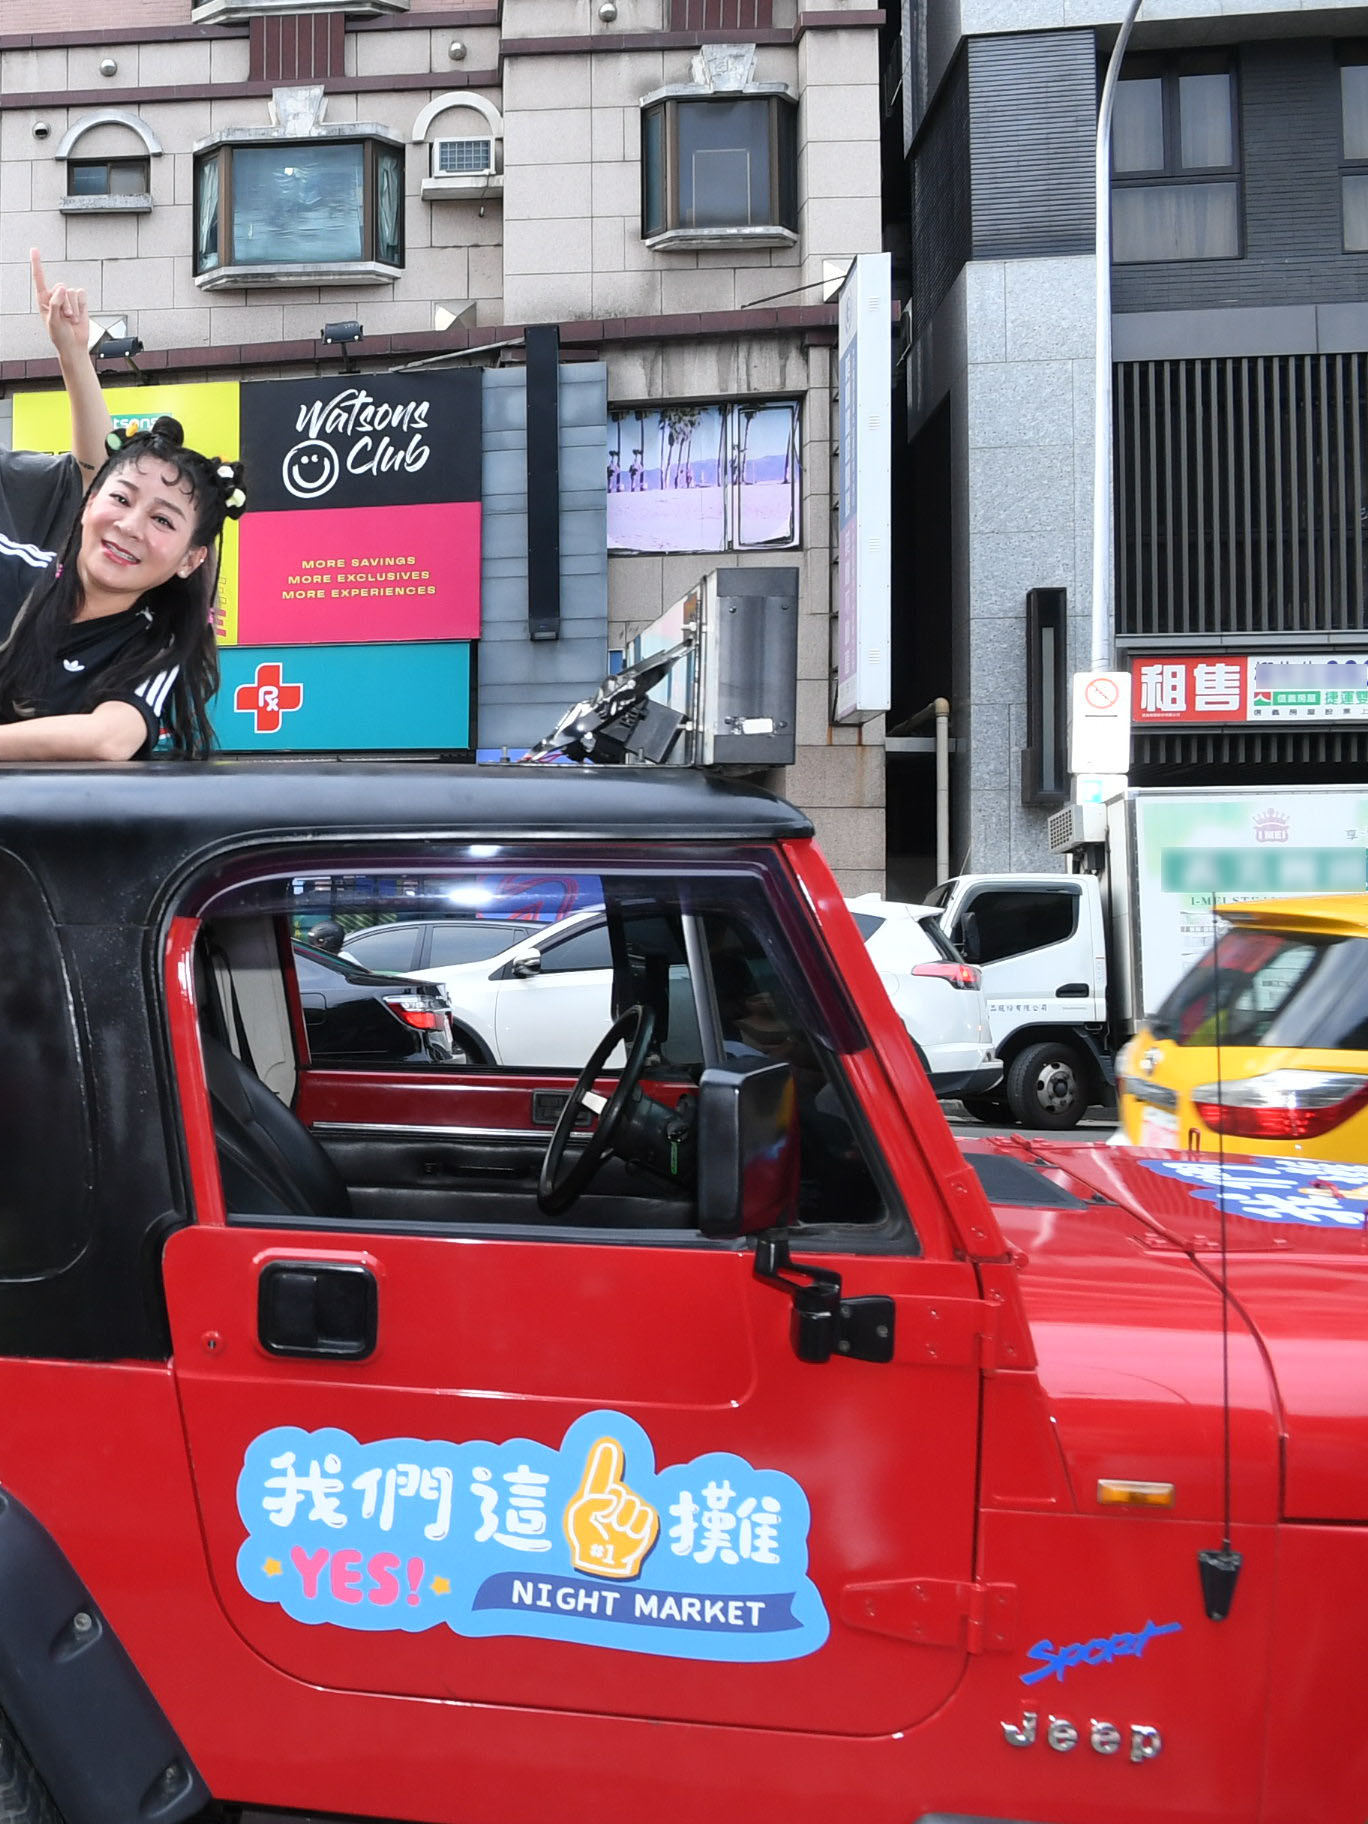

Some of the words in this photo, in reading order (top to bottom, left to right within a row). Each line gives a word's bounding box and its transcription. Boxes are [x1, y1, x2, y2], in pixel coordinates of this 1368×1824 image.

[296, 388, 430, 439] Watsons
[346, 433, 431, 476] Club
[288, 574, 332, 585] MORE
[337, 571, 430, 583] EXCLUSIVES
[301, 559, 346, 569] MORE
[351, 556, 416, 568] SAVINGS
[282, 589, 325, 599] MORE
[331, 586, 436, 598] EXPERIENCES
[1140, 663, 1241, 712] 租售
[291, 1545, 426, 1606] YES!
[589, 1543, 617, 1566] #1
[511, 1580, 621, 1617] NIGHT
[634, 1594, 766, 1627] MARKET
[1000, 1711, 1162, 1763] Jeep
